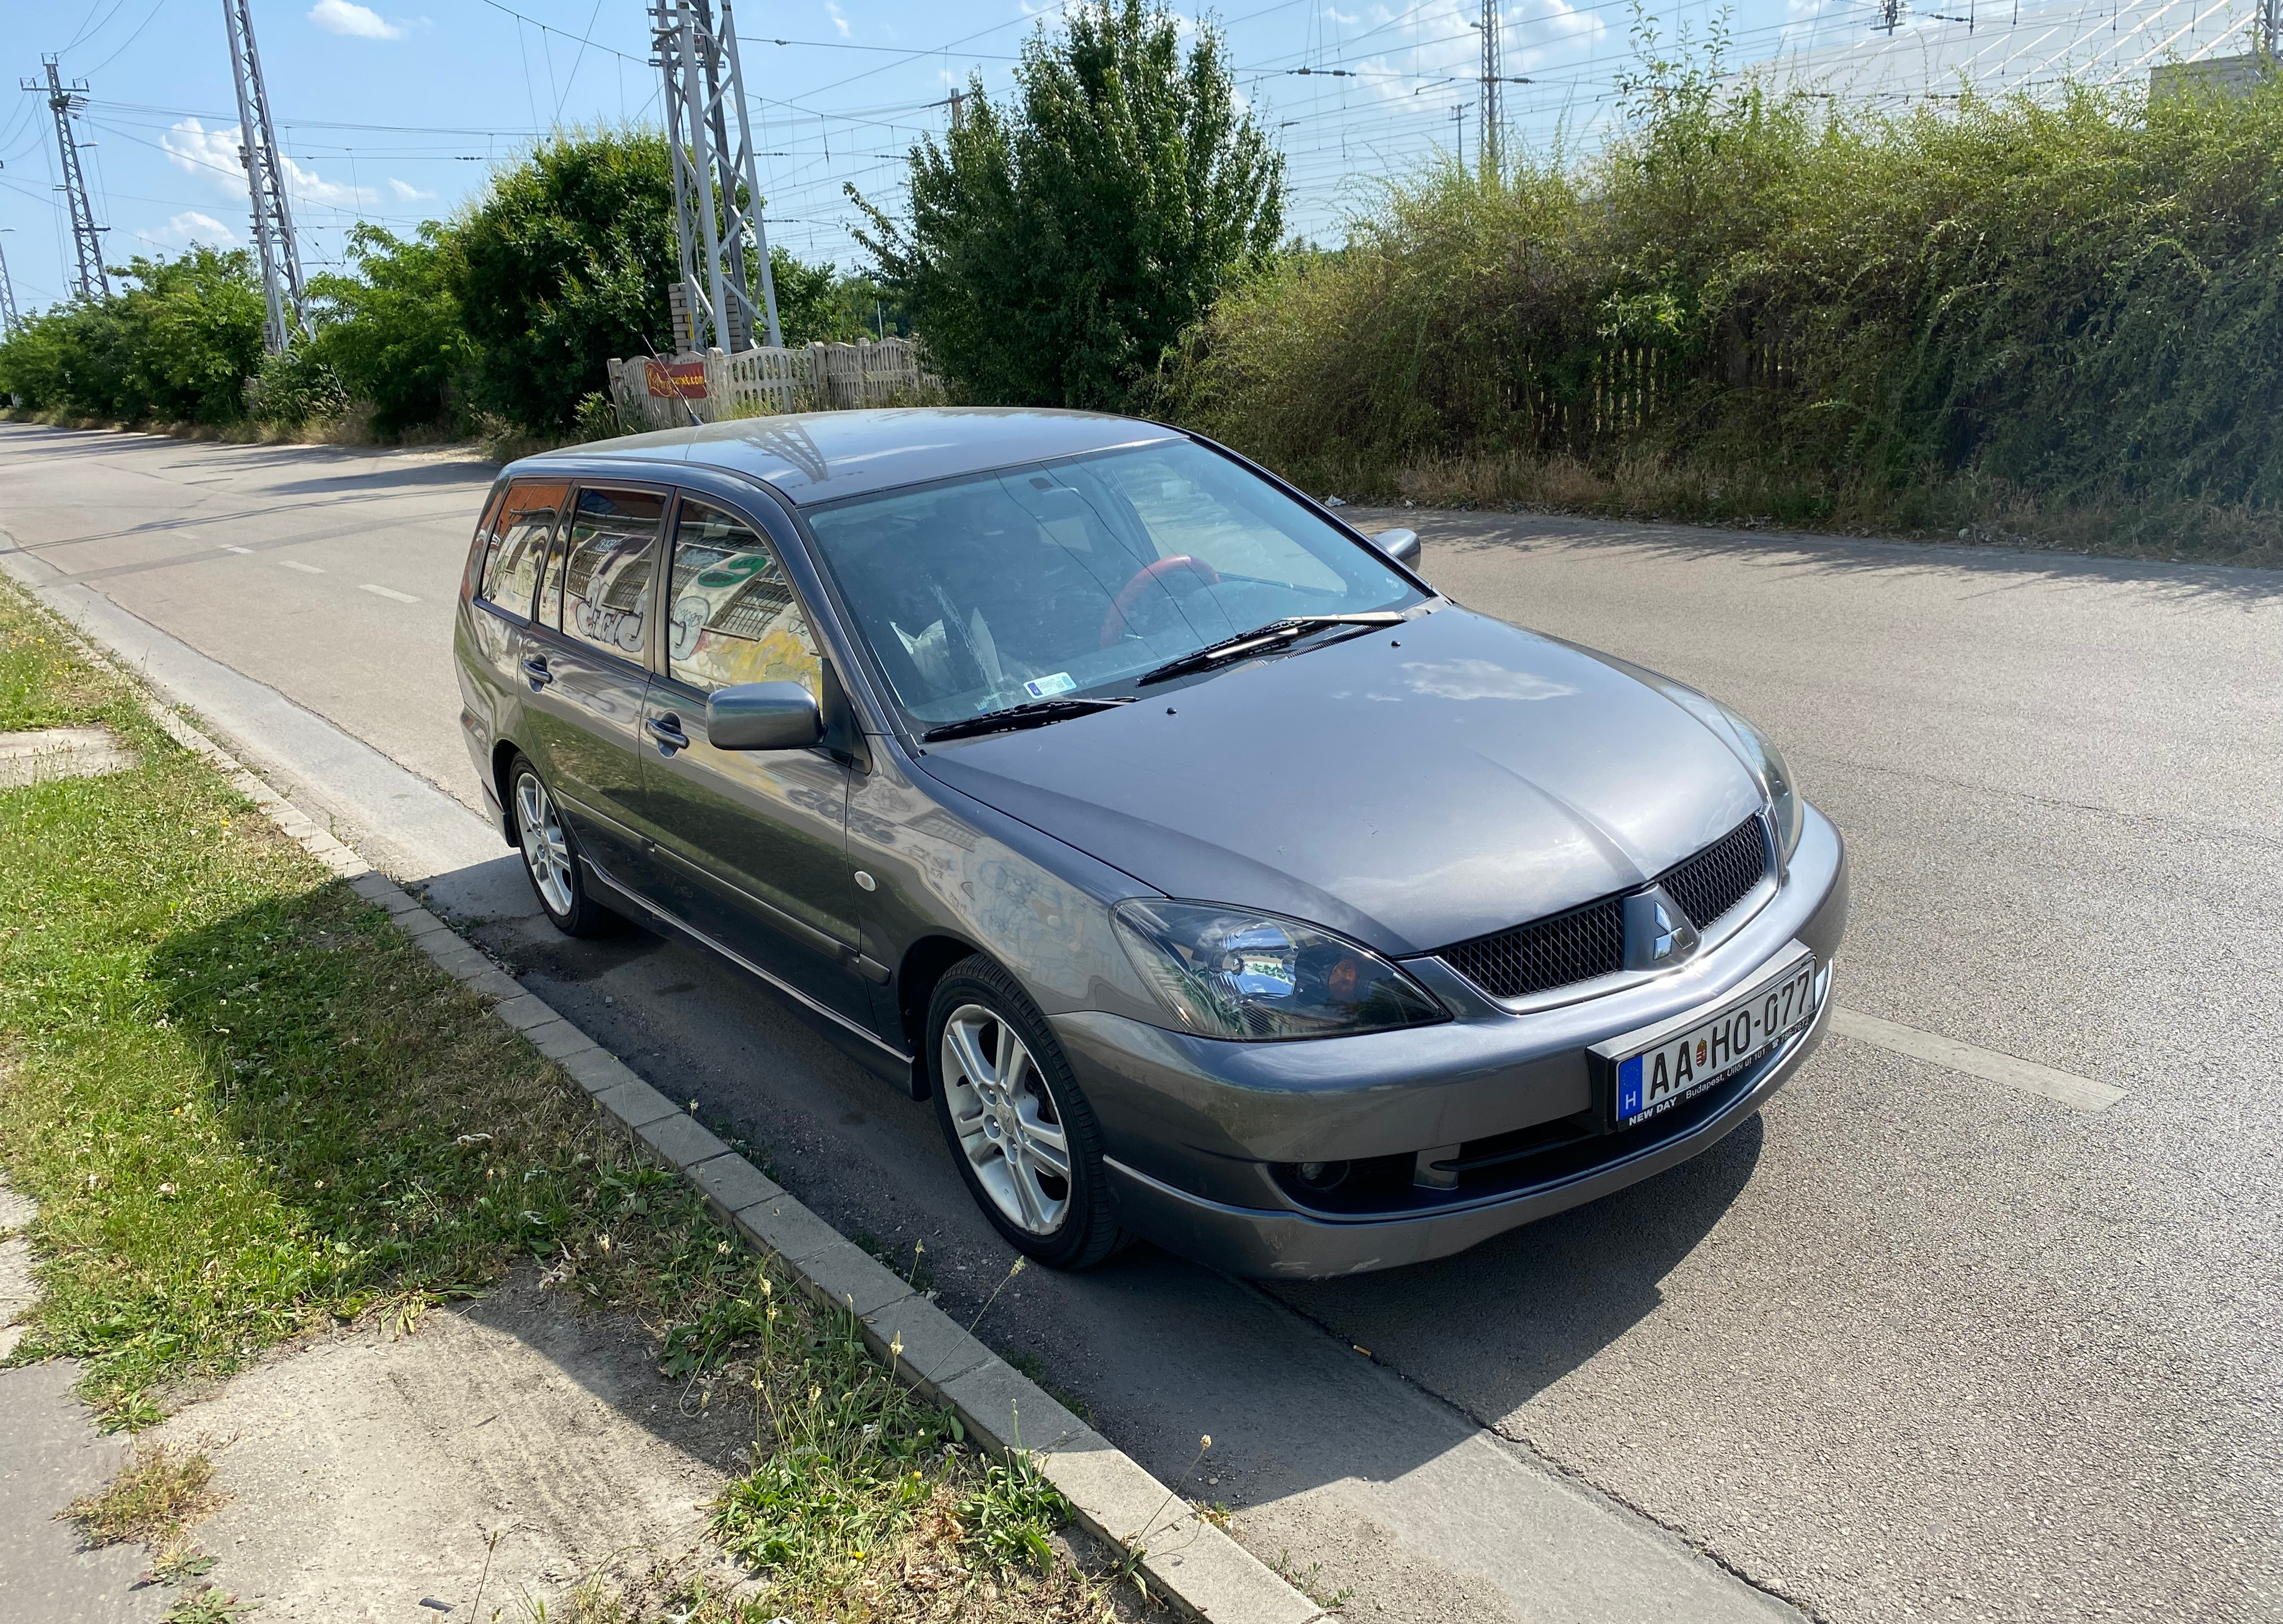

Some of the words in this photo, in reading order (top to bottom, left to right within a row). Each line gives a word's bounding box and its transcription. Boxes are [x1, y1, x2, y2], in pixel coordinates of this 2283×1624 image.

[1629, 1108, 1653, 1126] NEW
[1656, 1096, 1677, 1114] DAY
[1686, 1074, 1725, 1100] Budapest,
[1781, 1017, 1809, 1043] 786-7672
[1649, 1040, 1694, 1100] AA
[1711, 968, 1810, 1069] HO-077
[1625, 1090, 1636, 1110] H
